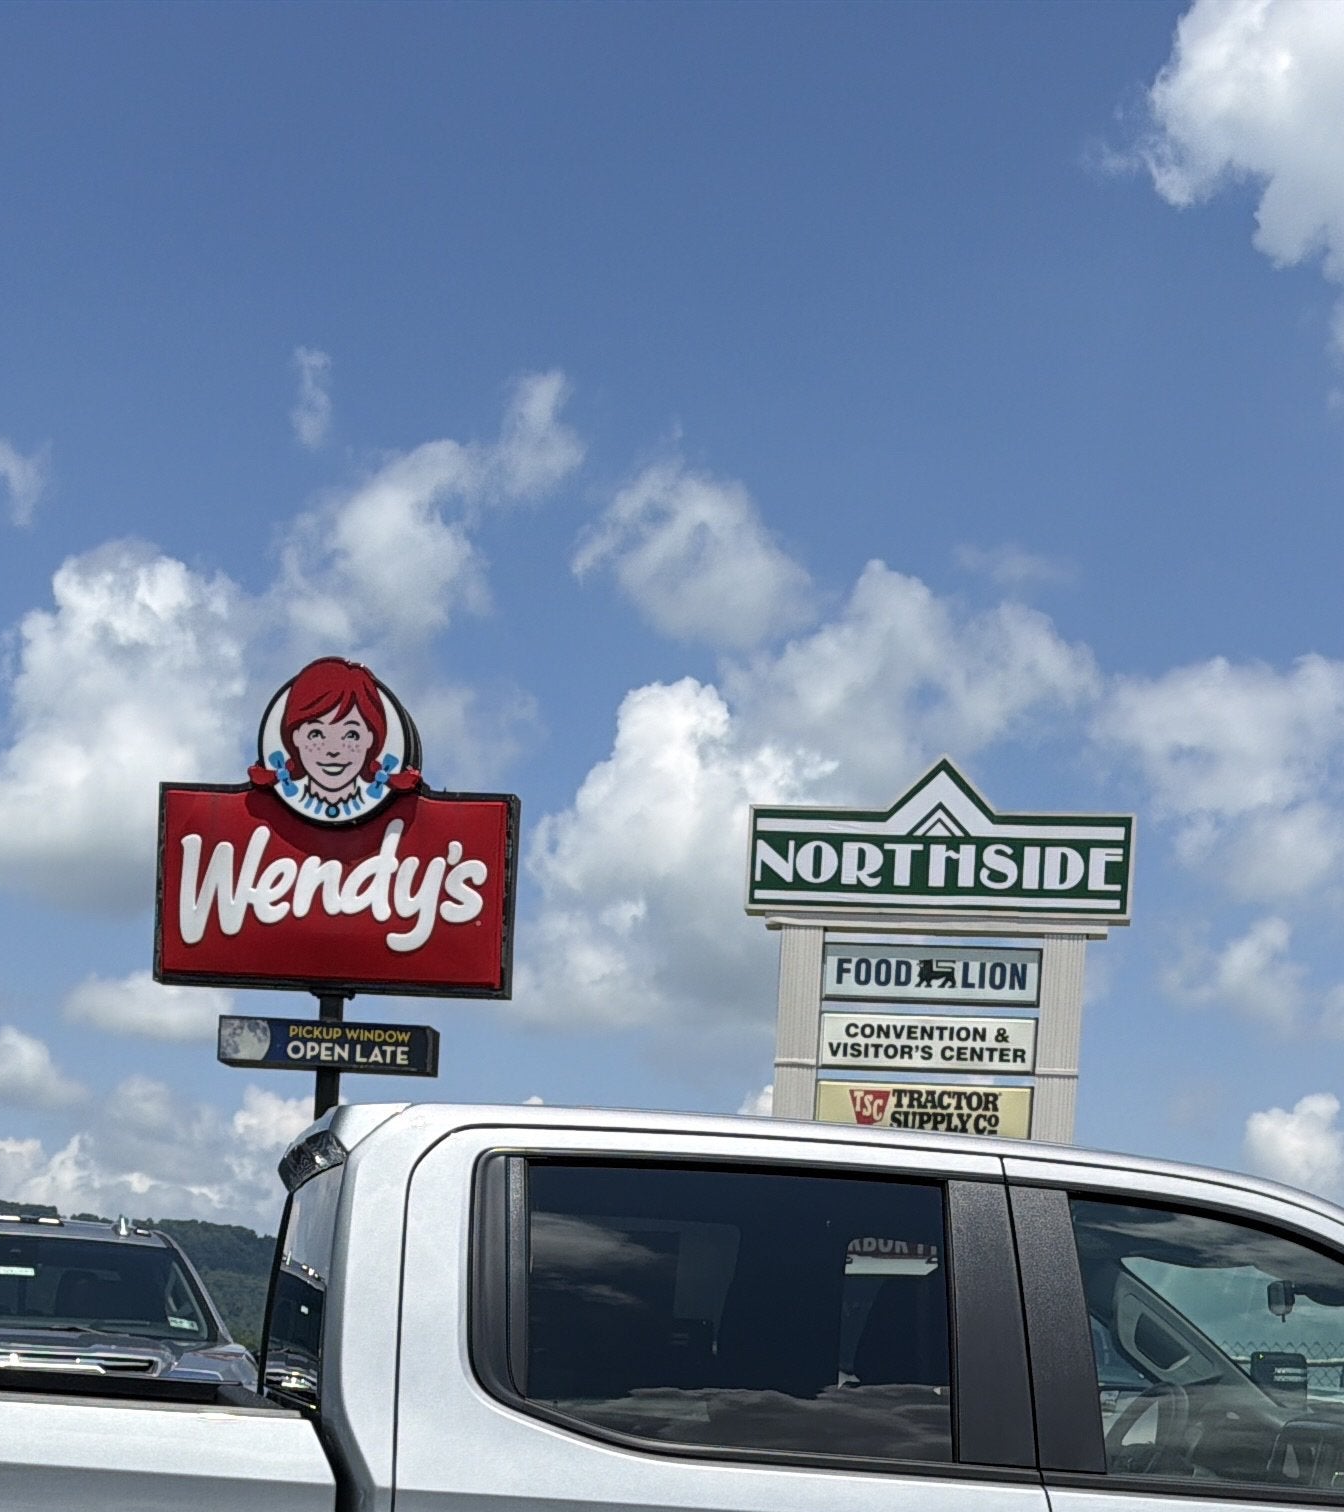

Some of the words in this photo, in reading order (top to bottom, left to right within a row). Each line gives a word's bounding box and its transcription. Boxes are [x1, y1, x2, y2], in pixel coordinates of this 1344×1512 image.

[754, 838, 1124, 892] NORTHSIDE
[178, 818, 488, 952] Wendy's
[835, 957, 913, 988] FOOD
[960, 961, 1028, 991] LION
[288, 1025, 342, 1040] PICKUP
[345, 1028, 411, 1043] WINDOW
[844, 1022, 988, 1043] CONVENTION
[994, 1027, 1010, 1044] &
[286, 1040, 349, 1062] OPEN
[355, 1043, 410, 1065] LATE
[828, 1042, 934, 1061] VISITOR'S
[940, 1045, 1026, 1064] CENTER
[853, 1090, 884, 1121] TSC
[892, 1089, 999, 1112] TRACTOR
[889, 1110, 973, 1133] SUPPLY
